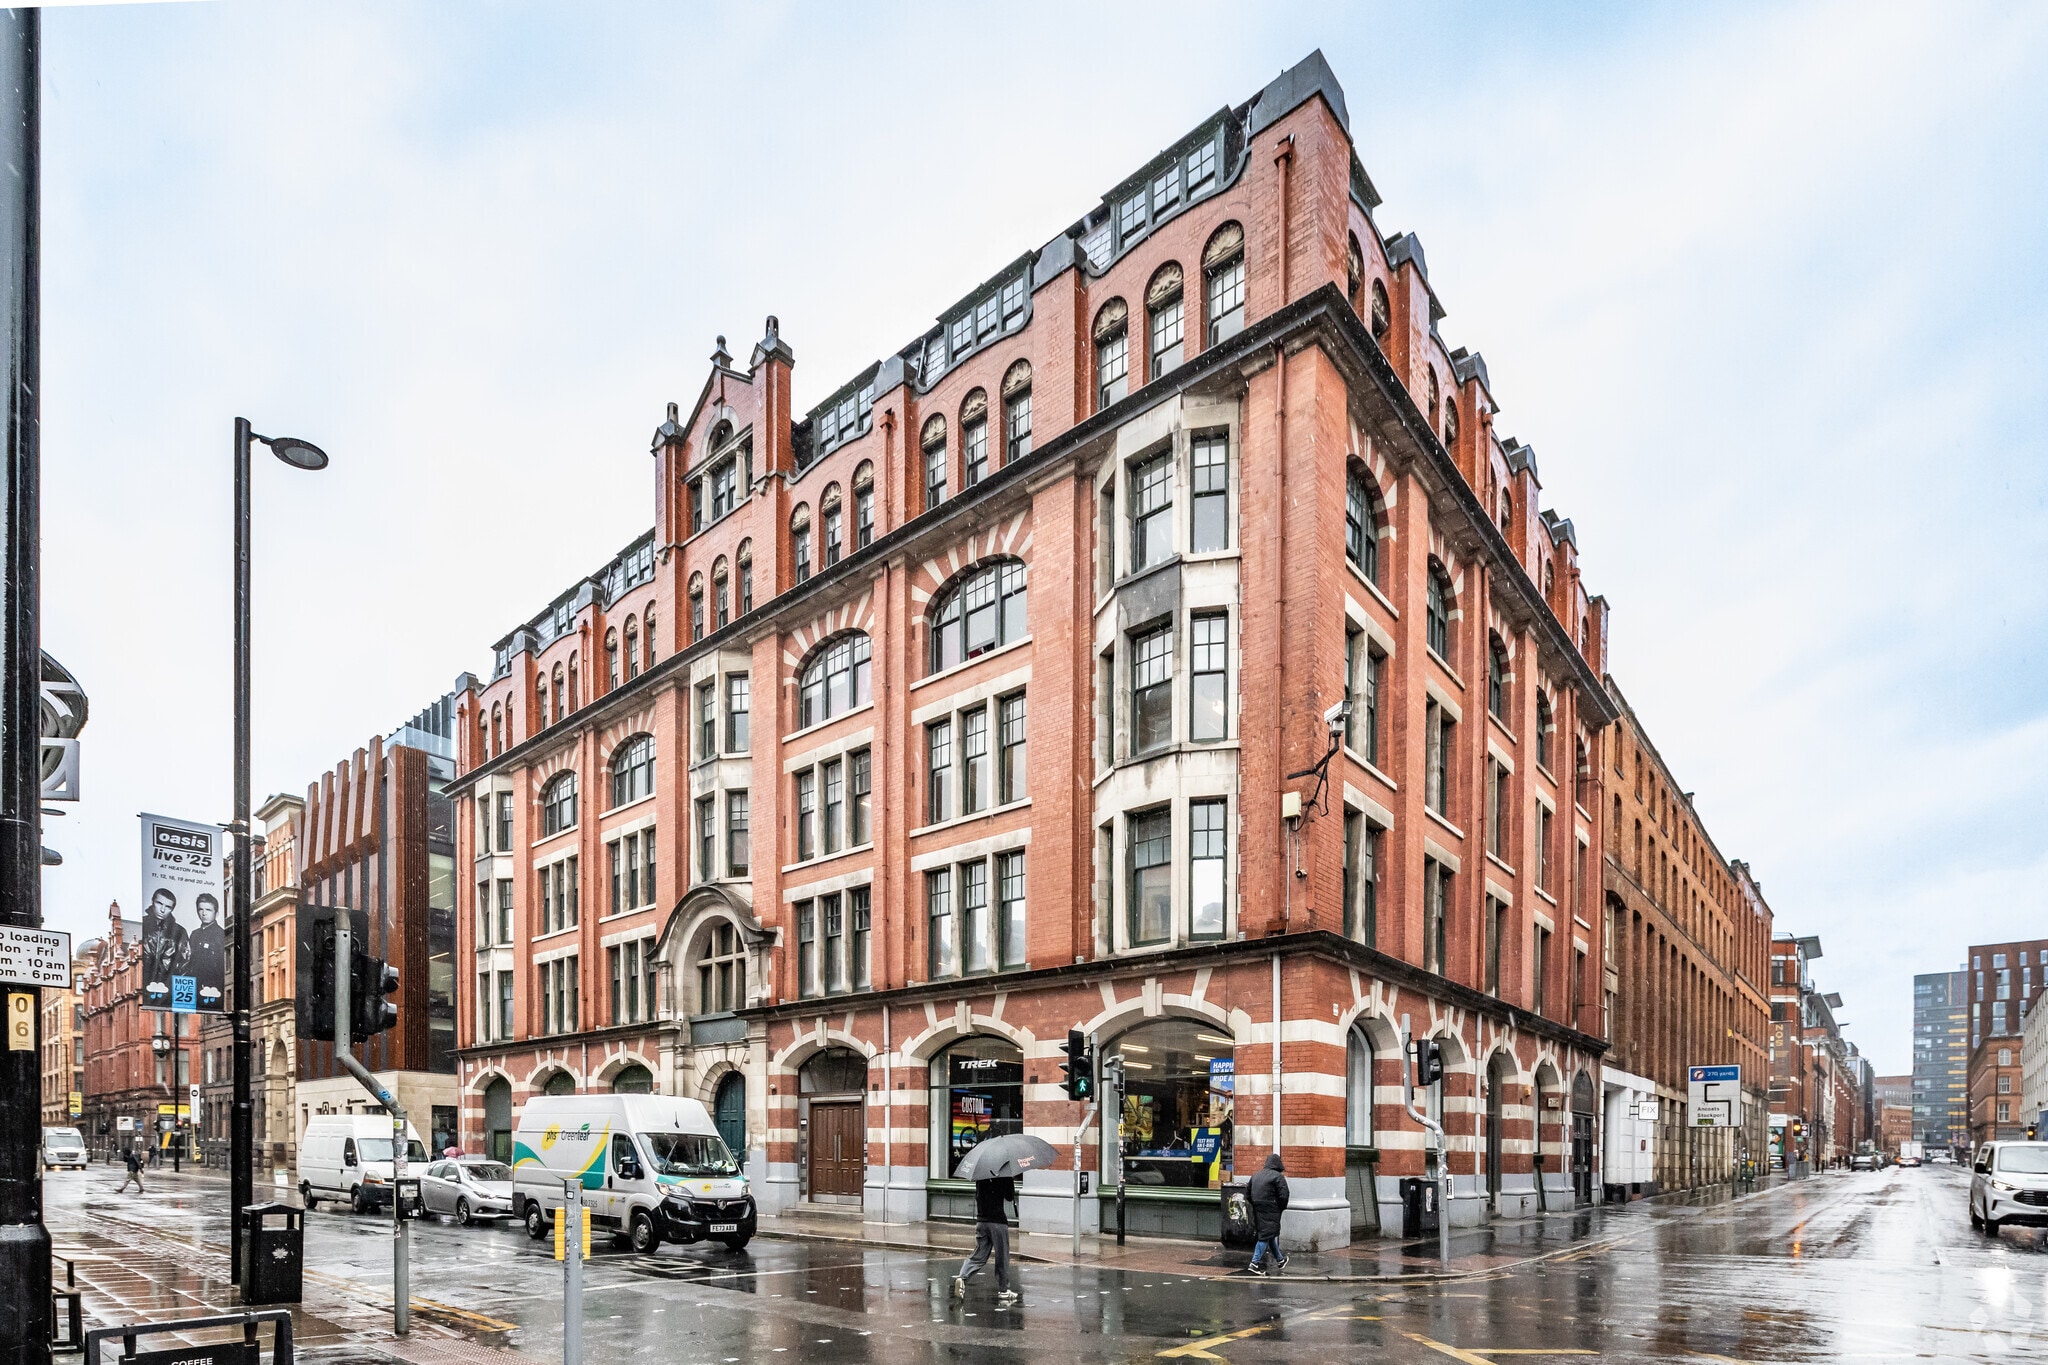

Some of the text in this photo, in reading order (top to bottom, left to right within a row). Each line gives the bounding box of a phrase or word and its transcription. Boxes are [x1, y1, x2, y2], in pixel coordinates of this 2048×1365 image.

[158, 832, 207, 849] oasis
[152, 847, 184, 863] live
[168, 865, 191, 873] HEATON
[191, 868, 207, 876] PARK
[10, 931, 60, 947] loading
[37, 947, 54, 957] Fri
[174, 978, 194, 986] MCR
[174, 984, 194, 992] LIVE
[174, 991, 194, 1003] 25
[959, 1059, 999, 1069] TREK
[961, 1096, 984, 1114] CUSTOM
[546, 1130, 590, 1142] phs Greenleaf
